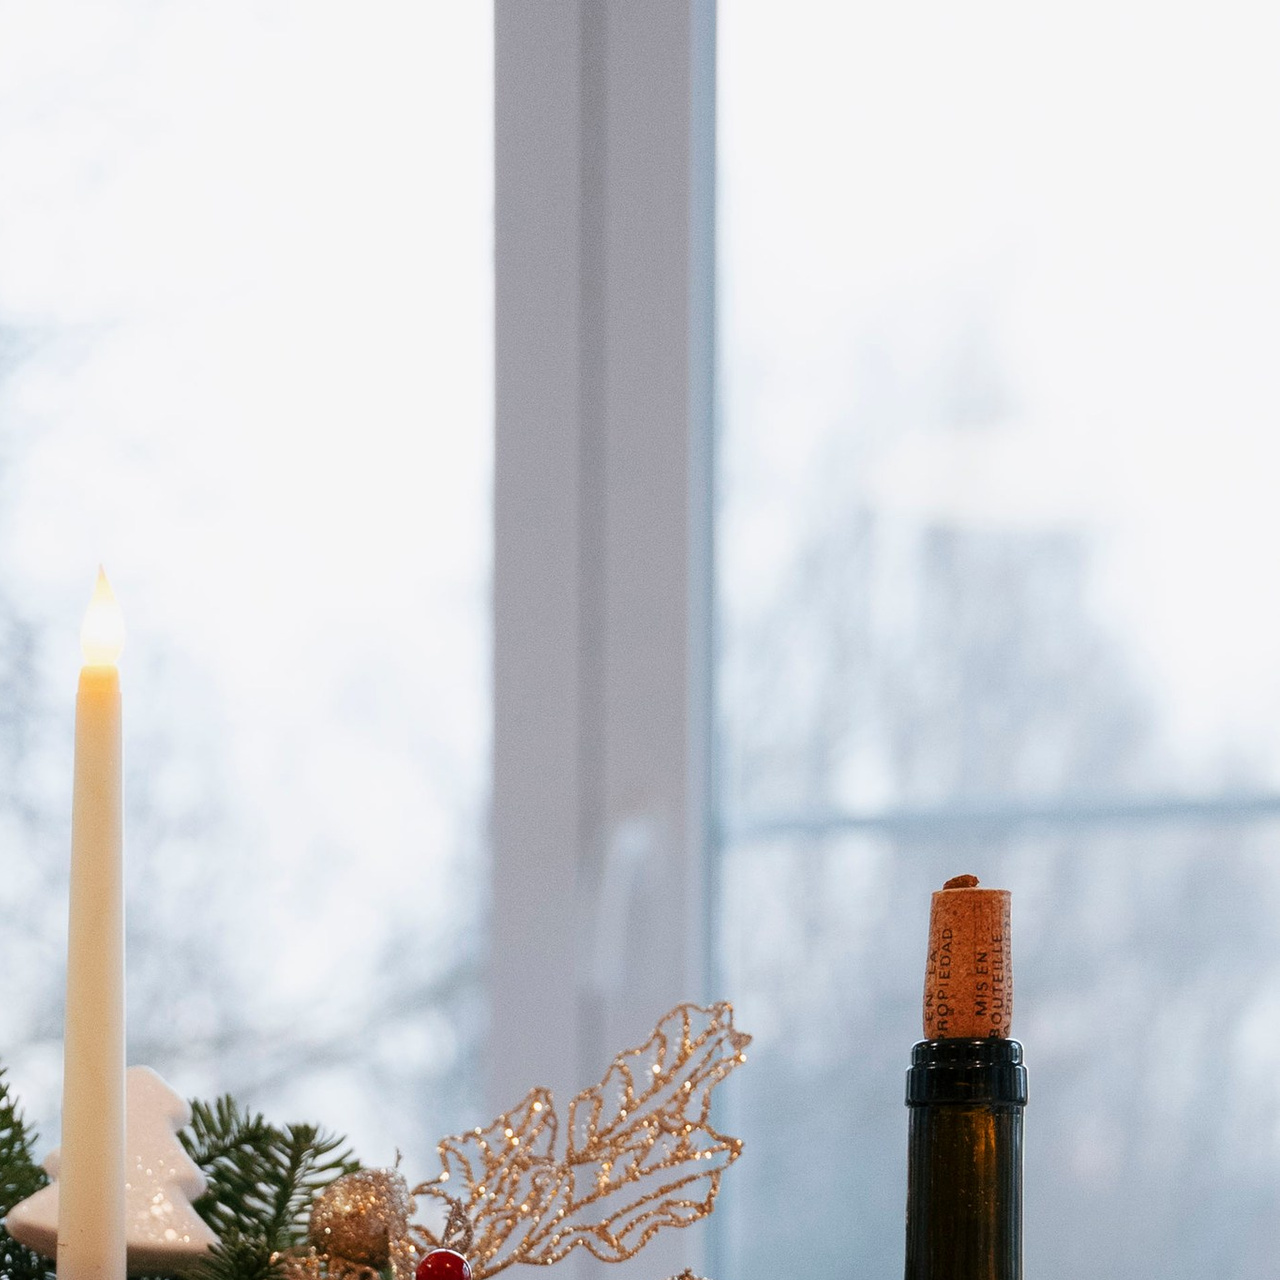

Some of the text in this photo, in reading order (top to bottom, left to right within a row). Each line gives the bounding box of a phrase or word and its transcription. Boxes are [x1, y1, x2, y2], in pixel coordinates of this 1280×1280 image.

[925, 950, 937, 1022] EN LA
[975, 952, 989, 1017] MIS EN
[989, 933, 1004, 1038] BOUTEILLE
